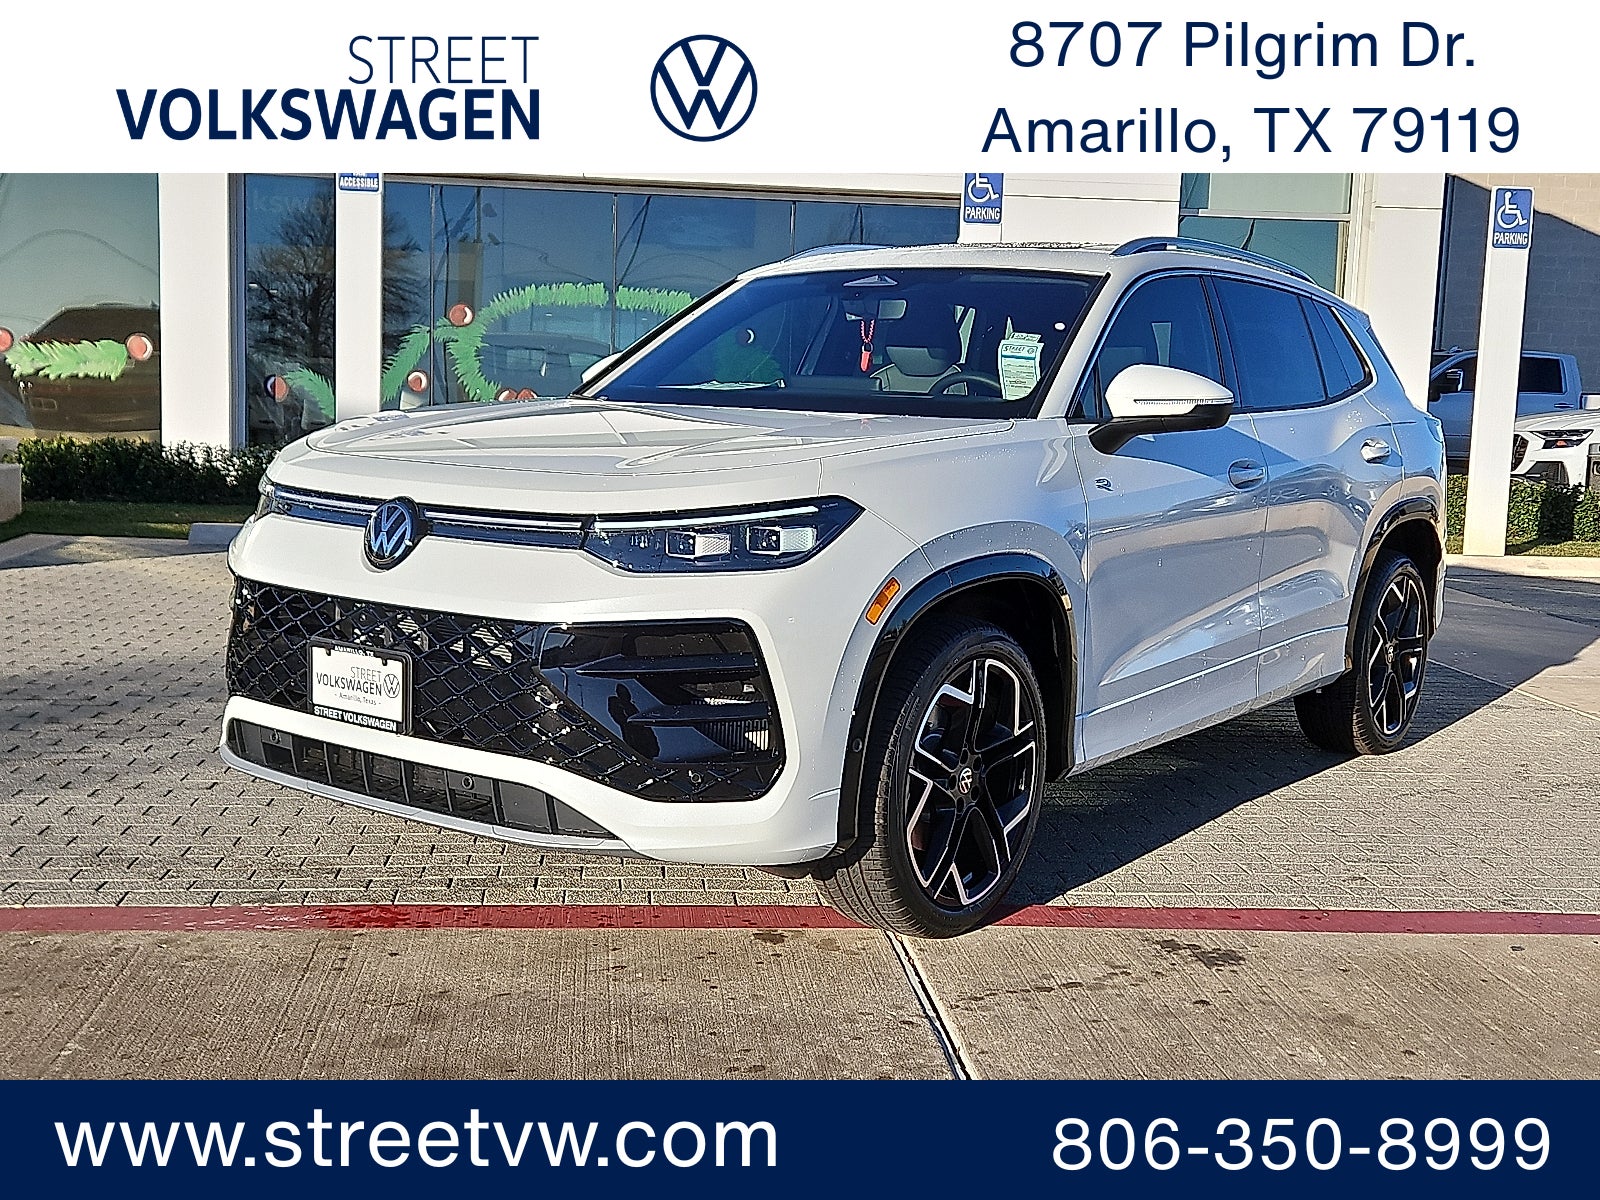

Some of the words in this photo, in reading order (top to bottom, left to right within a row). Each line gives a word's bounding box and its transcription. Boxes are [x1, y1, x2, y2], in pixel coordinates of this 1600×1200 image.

[340, 176, 379, 188] ACCESSIBLE
[965, 206, 1001, 220] PARKING
[1493, 232, 1528, 245] PARKING
[350, 666, 382, 683] STREET
[316, 671, 382, 696] VOLKSWAGEN
[314, 705, 343, 720] STREET
[343, 711, 397, 732] VOLKSWAGEN
